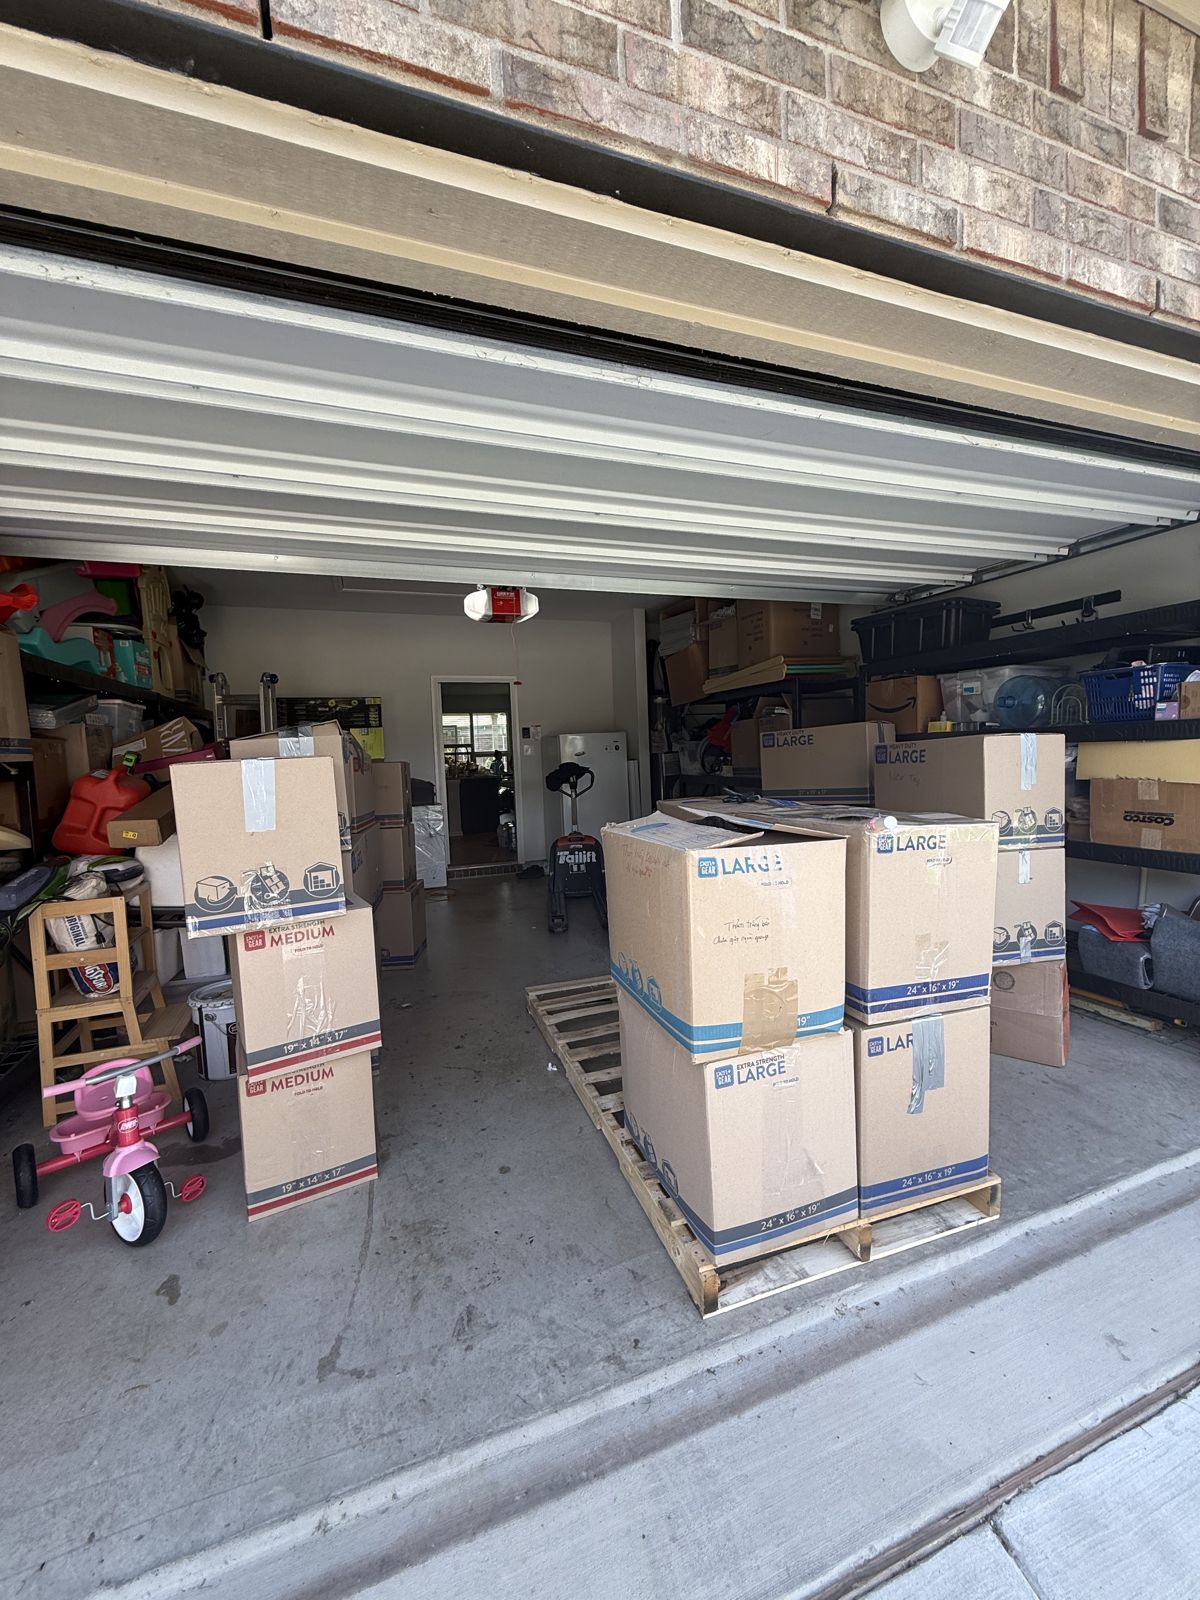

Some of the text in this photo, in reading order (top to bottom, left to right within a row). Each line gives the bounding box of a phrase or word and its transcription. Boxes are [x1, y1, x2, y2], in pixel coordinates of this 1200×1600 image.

[776, 734, 814, 747] LARGE
[888, 750, 926, 764] LARGE
[1123, 814, 1174, 826] COSTCO
[896, 834, 946, 852] LARGE
[557, 850, 597, 864] Tailift
[701, 866, 716, 875] GEAR
[268, 920, 325, 934] EXTRA STRENGTH
[248, 939, 263, 948] GEAR
[270, 925, 335, 948] MEDIUM
[906, 985, 921, 996] 24"
[929, 982, 940, 992] 16"
[948, 980, 960, 990] 19"
[798, 1016, 810, 1026] 19"
[283, 1043, 298, 1054] 19"
[309, 1035, 324, 1047] 14"
[334, 1030, 348, 1040] 17"
[870, 1045, 882, 1054] GEAR
[886, 1033, 914, 1052] LAR
[736, 1054, 785, 1070] EXTRA STRENGTH
[270, 1066, 334, 1092] MEDIUM
[737, 1060, 786, 1084] LARGE
[718, 1075, 732, 1085] GEAR
[250, 1085, 264, 1094] GEAR
[282, 1182, 296, 1193] 19"
[306, 1174, 322, 1185] 14"
[332, 1166, 346, 1176] 17"
[902, 1176, 916, 1188] 24"
[924, 1172, 936, 1182] 16"
[944, 1166, 956, 1176] 19"
[761, 1218, 776, 1230] 24"
[786, 1210, 800, 1222] 16"
[808, 1202, 820, 1214] 19"
